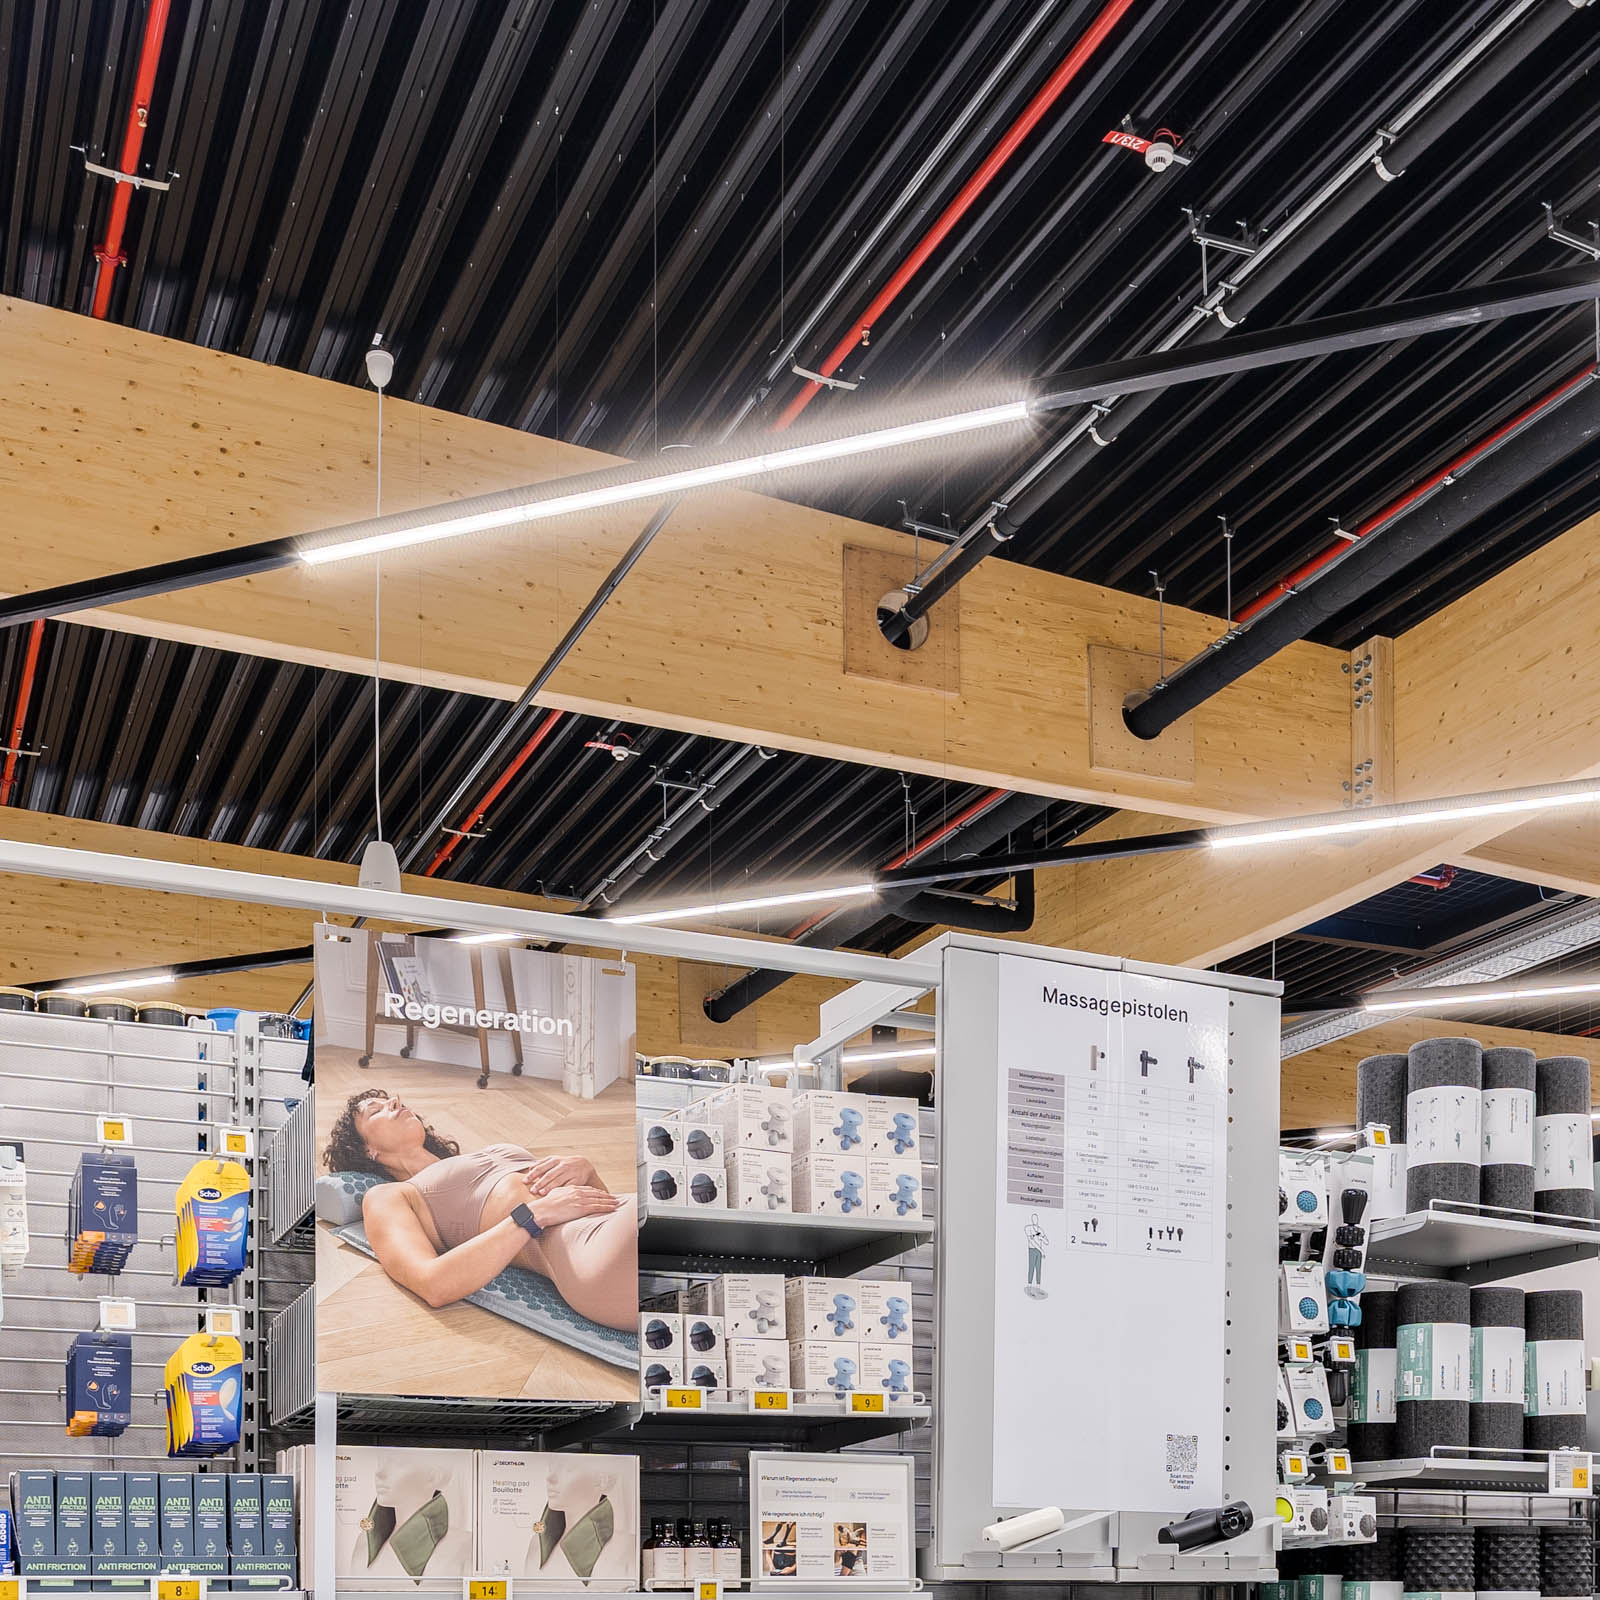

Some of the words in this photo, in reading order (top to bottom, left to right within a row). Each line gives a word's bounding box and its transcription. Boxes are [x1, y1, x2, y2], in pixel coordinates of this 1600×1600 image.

[1042, 985, 1189, 1024] Massagepistolen
[384, 993, 573, 1036] Regeneration
[199, 1190, 220, 1198] Scholl
[1071, 1236, 1076, 1244] 2
[193, 1364, 213, 1372] Scholl
[681, 1395, 686, 1404] 6
[768, 1396, 774, 1405] 9
[865, 1398, 870, 1408] 9
[26, 1496, 50, 1504] ANTI
[62, 1496, 86, 1505] ANTI
[97, 1497, 121, 1505] ANTI
[199, 1498, 222, 1506] ANTI
[268, 1499, 291, 1507] ANTI
[176, 1586, 181, 1596] 8
[482, 1587, 494, 1596] 14
